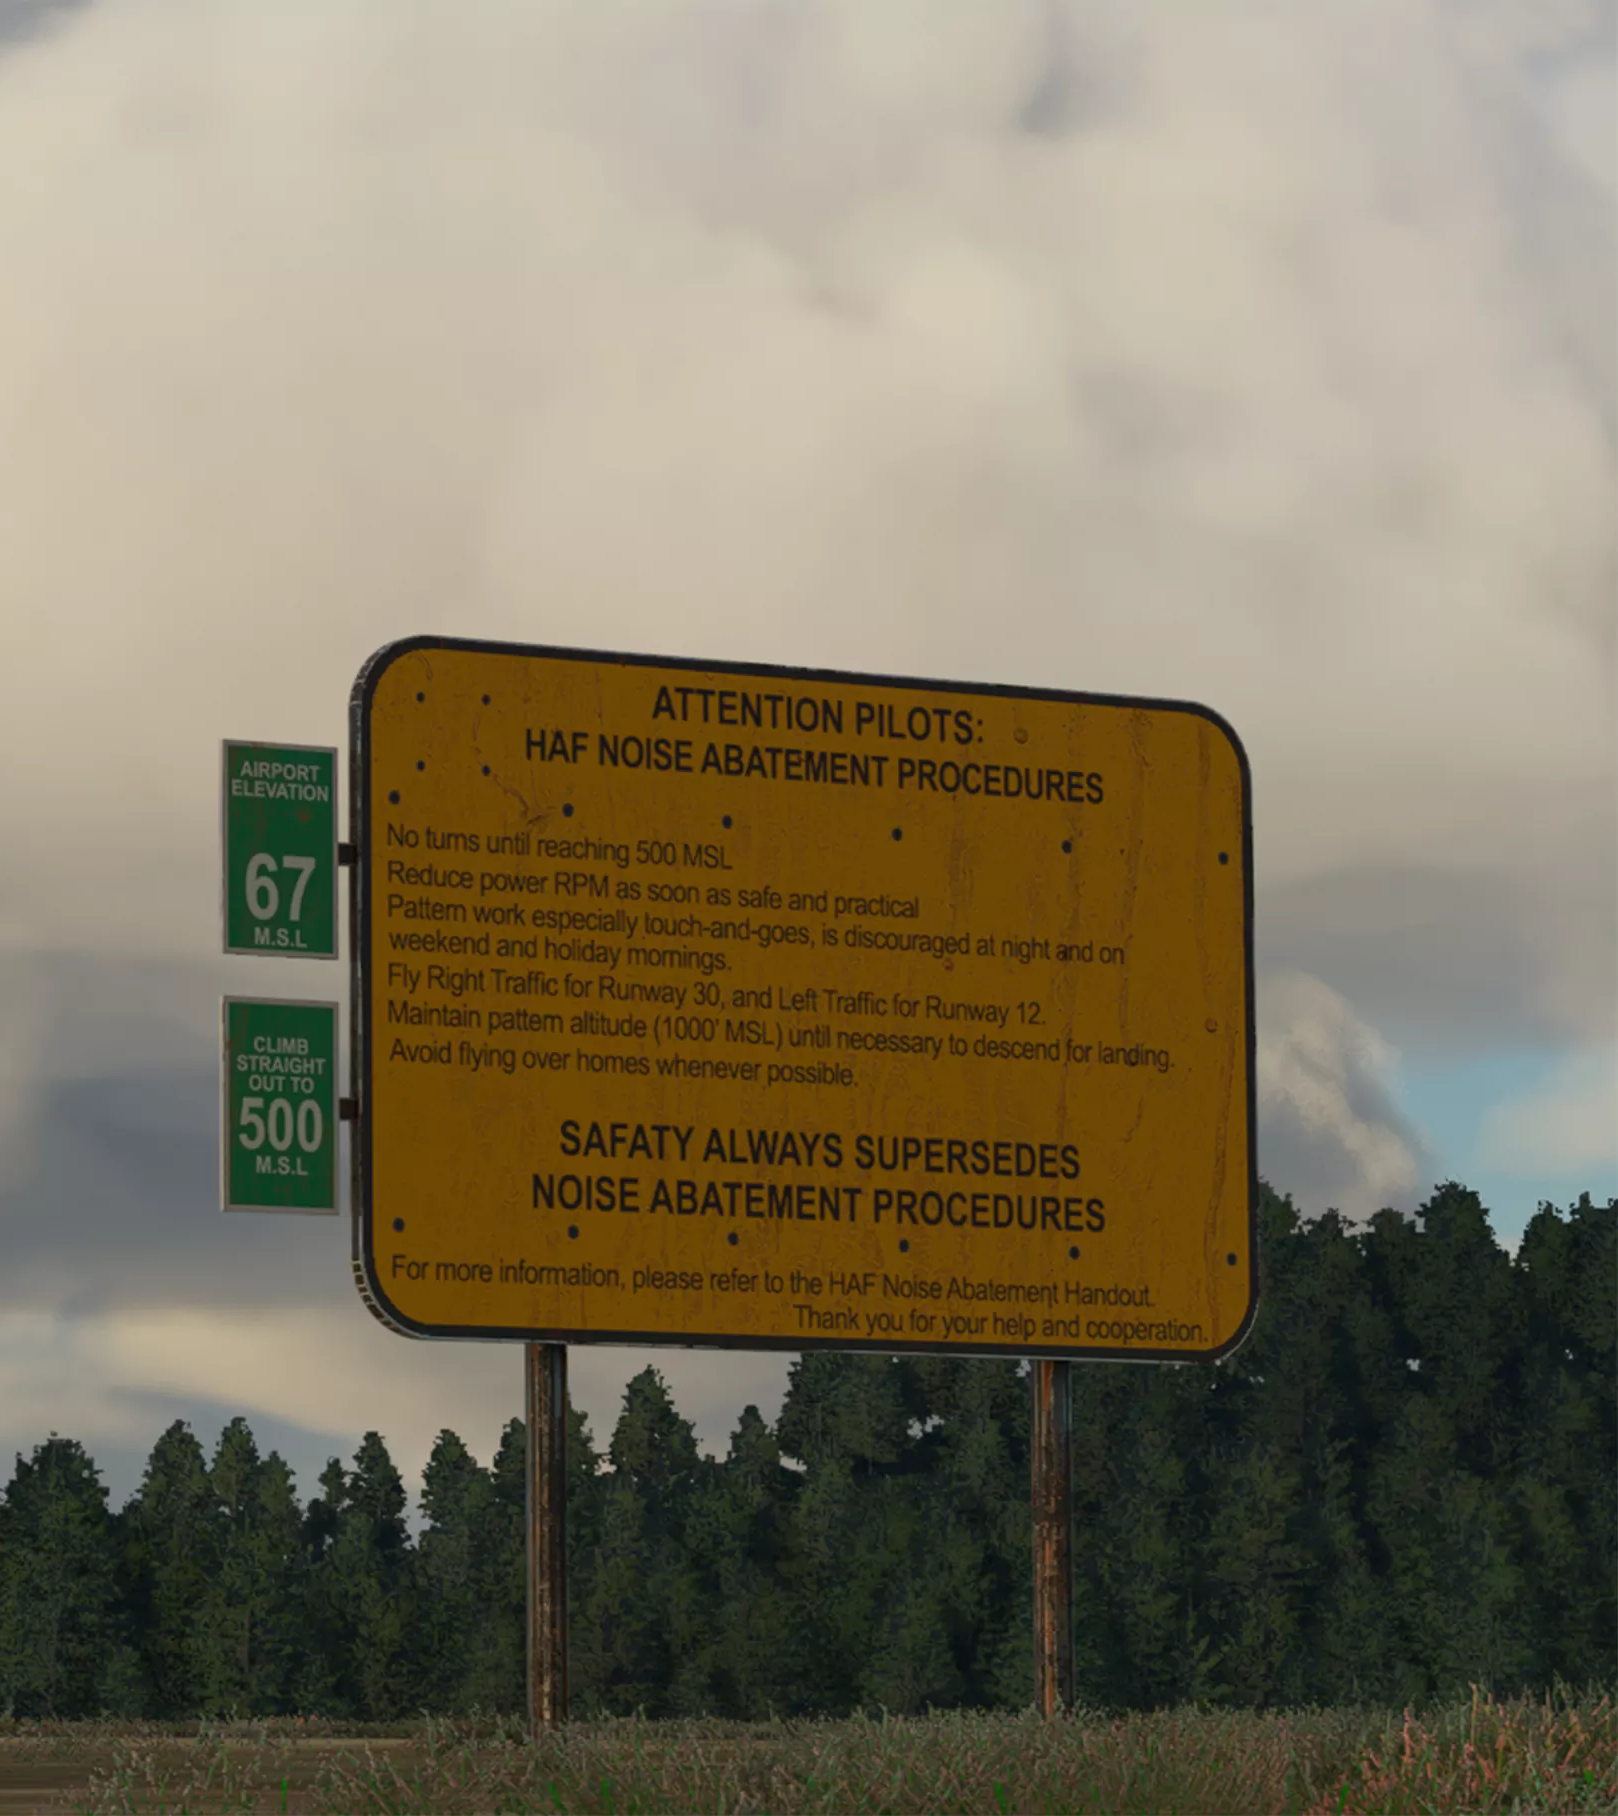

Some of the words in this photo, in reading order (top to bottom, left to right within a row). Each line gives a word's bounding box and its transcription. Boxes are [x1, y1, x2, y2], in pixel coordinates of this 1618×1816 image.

[652, 685, 843, 734] ATTENTION
[855, 701, 984, 745] PILOTS:
[231, 779, 329, 802] ELEVATION
[240, 760, 320, 782] AIRPORT
[525, 728, 589, 765] HAF
[598, 735, 693, 774] NOISE
[700, 742, 889, 788] ABATEMENT
[898, 758, 1104, 804] PROCEDURES
[387, 823, 419, 848] No
[425, 826, 480, 852] turns
[487, 830, 530, 856] until
[537, 836, 630, 869] reaching
[636, 841, 677, 866] 500
[683, 844, 732, 870] MSL
[245, 853, 316, 922] 67
[387, 860, 473, 889] Reduce
[481, 871, 547, 896] power
[554, 872, 609, 898] RPM
[616, 880, 641, 901] as
[648, 884, 700, 905] soon
[706, 887, 731, 907] as
[738, 886, 782, 910] safe
[788, 890, 827, 912] and
[835, 894, 919, 919] practical
[254, 927, 307, 948] M.S.L
[387, 894, 466, 923] Pattern
[473, 902, 526, 927] work
[531, 906, 638, 938] especially
[644, 912, 815, 948] touch-and-goes,
[821, 923, 839, 946] is
[845, 925, 970, 959] discouraged
[976, 936, 995, 956] at
[1001, 937, 1050, 965] night
[1056, 942, 1093, 963] and
[1099, 947, 1124, 965] on
[390, 929, 489, 956] weekend
[497, 935, 537, 959] and
[545, 937, 621, 970] holiday
[628, 947, 732, 976] mornings.
[388, 963, 420, 993] Fly
[428, 965, 484, 997] Right
[491, 968, 558, 997] Traffic
[564, 973, 592, 998] for
[599, 976, 686, 1009] Runway
[692, 982, 724, 1009] 30,
[732, 985, 772, 1009] and
[779, 988, 817, 1012] Left
[823, 989, 887, 1017] Traffic
[892, 993, 920, 1018] for
[925, 996, 1009, 1028] Runway
[1016, 1002, 1046, 1026] 12.
[253, 1036, 309, 1054] CLIMB
[388, 1000, 481, 1029] Maintain
[488, 1010, 563, 1036] pattern
[570, 1012, 647, 1038] altitude
[725, 1019, 782, 1051] MSL)
[788, 1025, 831, 1048] until
[837, 1030, 942, 1060] necessary
[949, 1035, 967, 1056] to
[973, 1038, 1060, 1063] descend
[1066, 1041, 1092, 1064] for
[1098, 1042, 1175, 1073] landing.
[237, 1055, 326, 1075] STRAIGHT
[249, 1075, 286, 1092] OUT
[290, 1076, 315, 1094] TO
[390, 1038, 451, 1065] Avoid
[459, 1042, 516, 1073] flying
[522, 1048, 570, 1070] over
[577, 1048, 650, 1076] homes
[656, 1055, 761, 1082] whenever
[767, 1062, 858, 1087] possible.
[238, 1096, 323, 1152] 500
[255, 1155, 308, 1175] M.S.L
[560, 1120, 693, 1161] SAFATY
[702, 1128, 842, 1168] ALWAYS
[855, 1134, 1080, 1179] SUPERSEDES
[532, 1173, 639, 1213] NOISE
[649, 1180, 861, 1223] ABATEMENT
[873, 1190, 1106, 1232] PROCEDURES
[392, 1254, 429, 1281] For
[435, 1260, 492, 1282] more
[500, 1259, 626, 1290] information,
[632, 1265, 703, 1293] please
[710, 1268, 759, 1293] refer
[764, 1271, 783, 1293] to
[790, 1272, 822, 1296] the
[830, 1272, 877, 1297] HAF
[882, 1273, 942, 1299] Noise
[947, 1276, 1058, 1304] Abatement
[793, 1305, 860, 1331] Thank
[865, 1311, 903, 1337] you
[910, 1309, 937, 1333] for
[943, 1315, 987, 1340] your
[993, 1312, 1035, 1341] help
[1042, 1315, 1079, 1338] and
[1086, 1317, 1209, 1344] cooperation.
